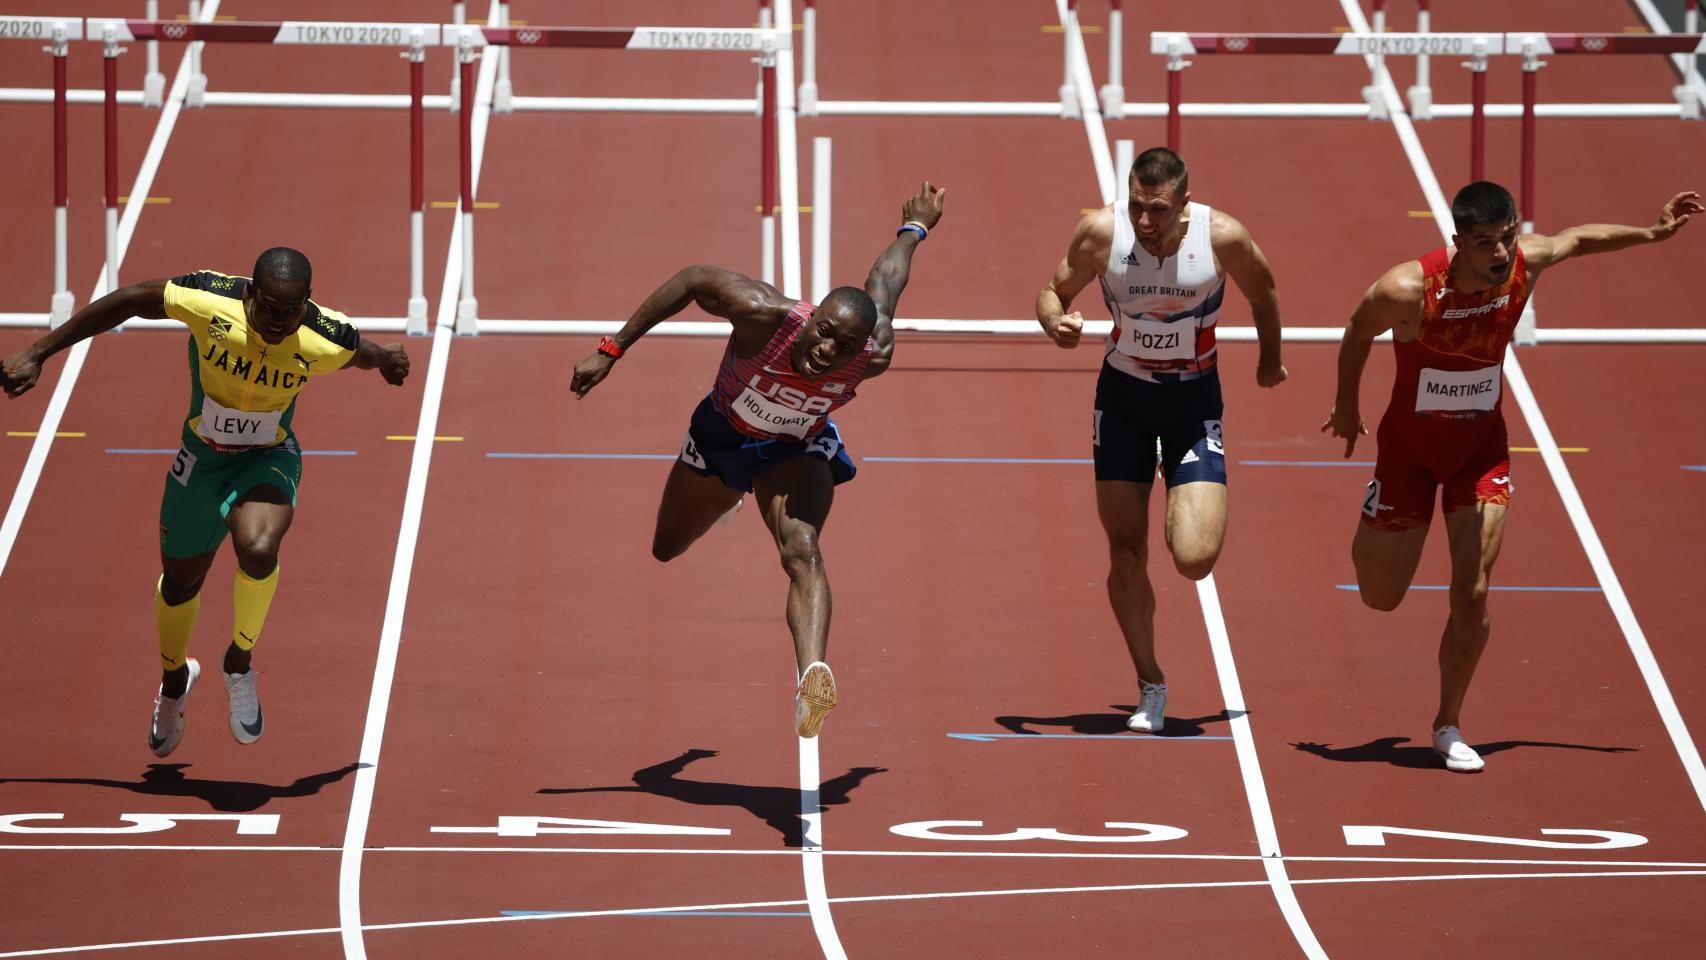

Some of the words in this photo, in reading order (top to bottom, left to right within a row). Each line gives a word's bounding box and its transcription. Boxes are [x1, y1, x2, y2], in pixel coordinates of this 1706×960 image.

[0, 21, 43, 36] 2020
[296, 26, 354, 42] TOKYO
[359, 27, 402, 43] 2020
[648, 31, 706, 47] TOKYO
[711, 32, 754, 48] 2020
[1357, 37, 1415, 53] TOKYO
[1419, 37, 1463, 53] 2020
[1129, 285, 1157, 295] GREAT
[1160, 285, 1197, 297] BRITAIN
[1133, 329, 1179, 349] POZZI
[748, 374, 832, 414] USA
[1426, 379, 1493, 398] MARTINEZ
[743, 395, 810, 427] HOLLOWAY
[214, 415, 261, 434] LEVY
[172, 448, 189, 477] 5
[685, 442, 699, 463] 4
[1363, 481, 1377, 512] 2
[0, 813, 281, 834] 5
[430, 816, 731, 836] 4
[889, 820, 1189, 842] 3
[1342, 825, 1649, 850] 2
